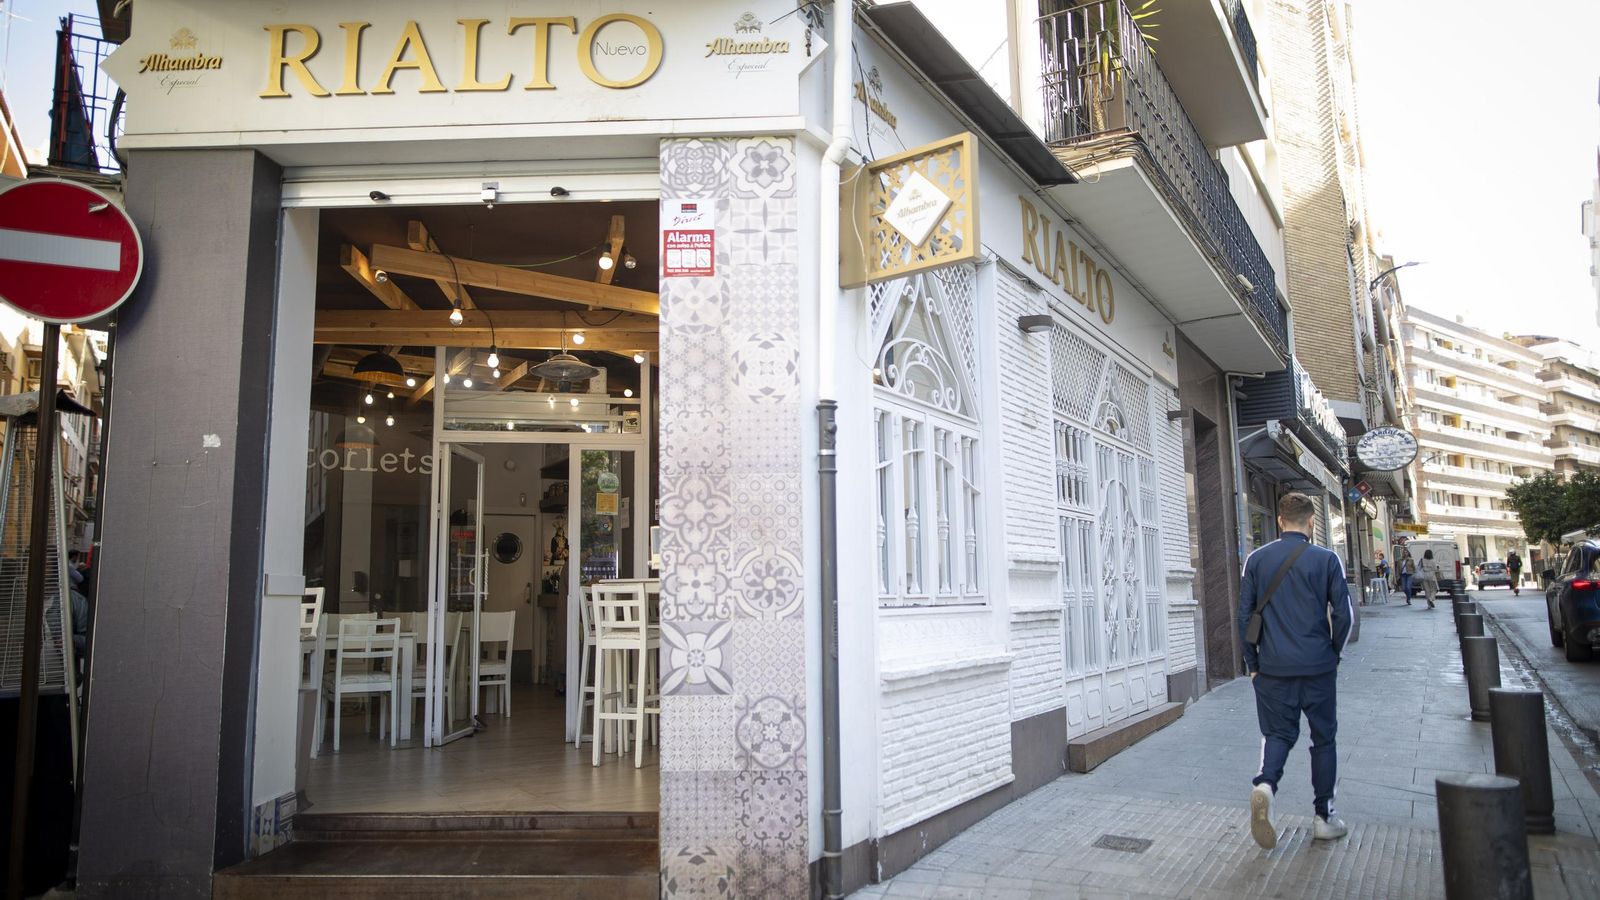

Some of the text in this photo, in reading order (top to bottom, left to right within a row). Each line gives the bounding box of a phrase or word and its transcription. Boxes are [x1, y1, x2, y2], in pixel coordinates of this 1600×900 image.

[259, 12, 665, 98] RIALTO
[595, 40, 647, 56] Nuevo
[704, 37, 790, 58] Alhambra
[138, 53, 223, 74] Alhambra
[667, 231, 711, 242] Alarma
[1018, 194, 1115, 325] RIALTO
